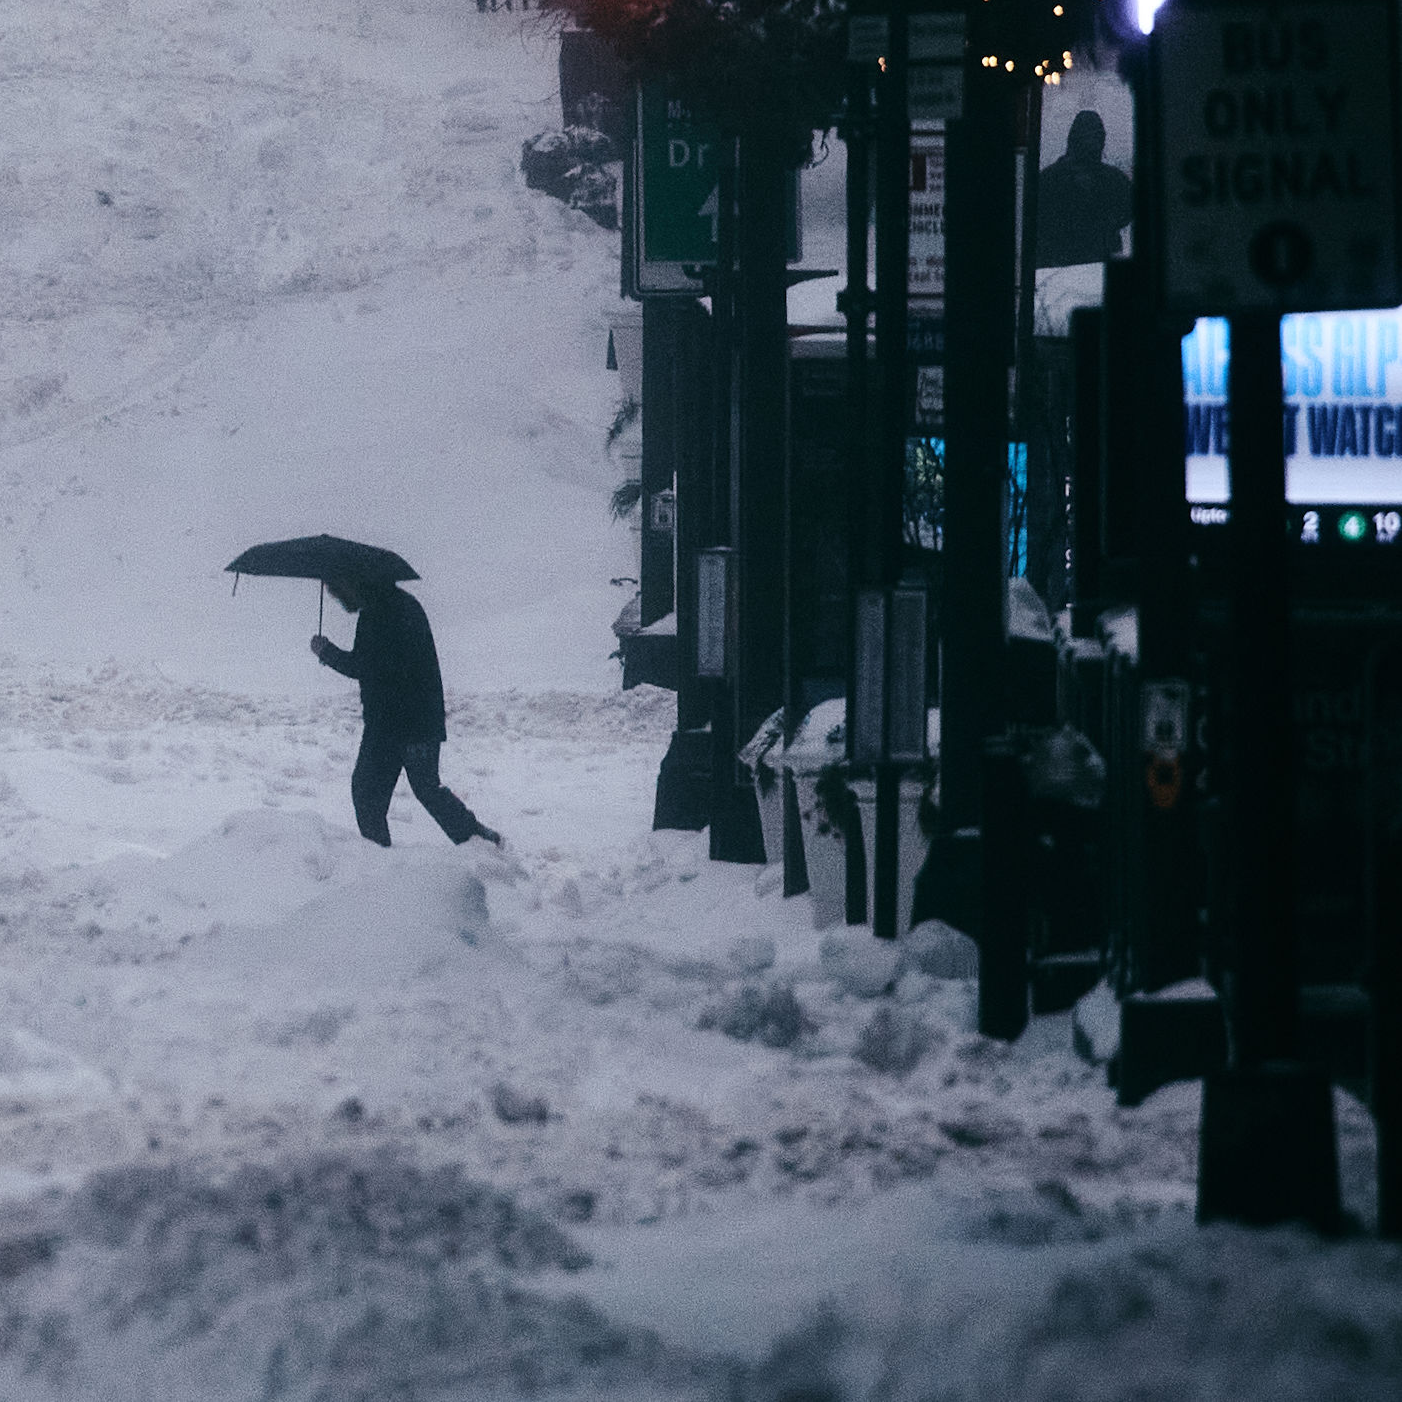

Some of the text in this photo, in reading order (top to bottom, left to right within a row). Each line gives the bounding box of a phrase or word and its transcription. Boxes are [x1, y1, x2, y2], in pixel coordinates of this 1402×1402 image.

[1220, 20, 1331, 76] BUS
[1201, 87, 1351, 139] ONLY
[667, 137, 711, 170] Dr
[1179, 153, 1376, 207] SIGNAL
[1301, 510, 1321, 532] 2
